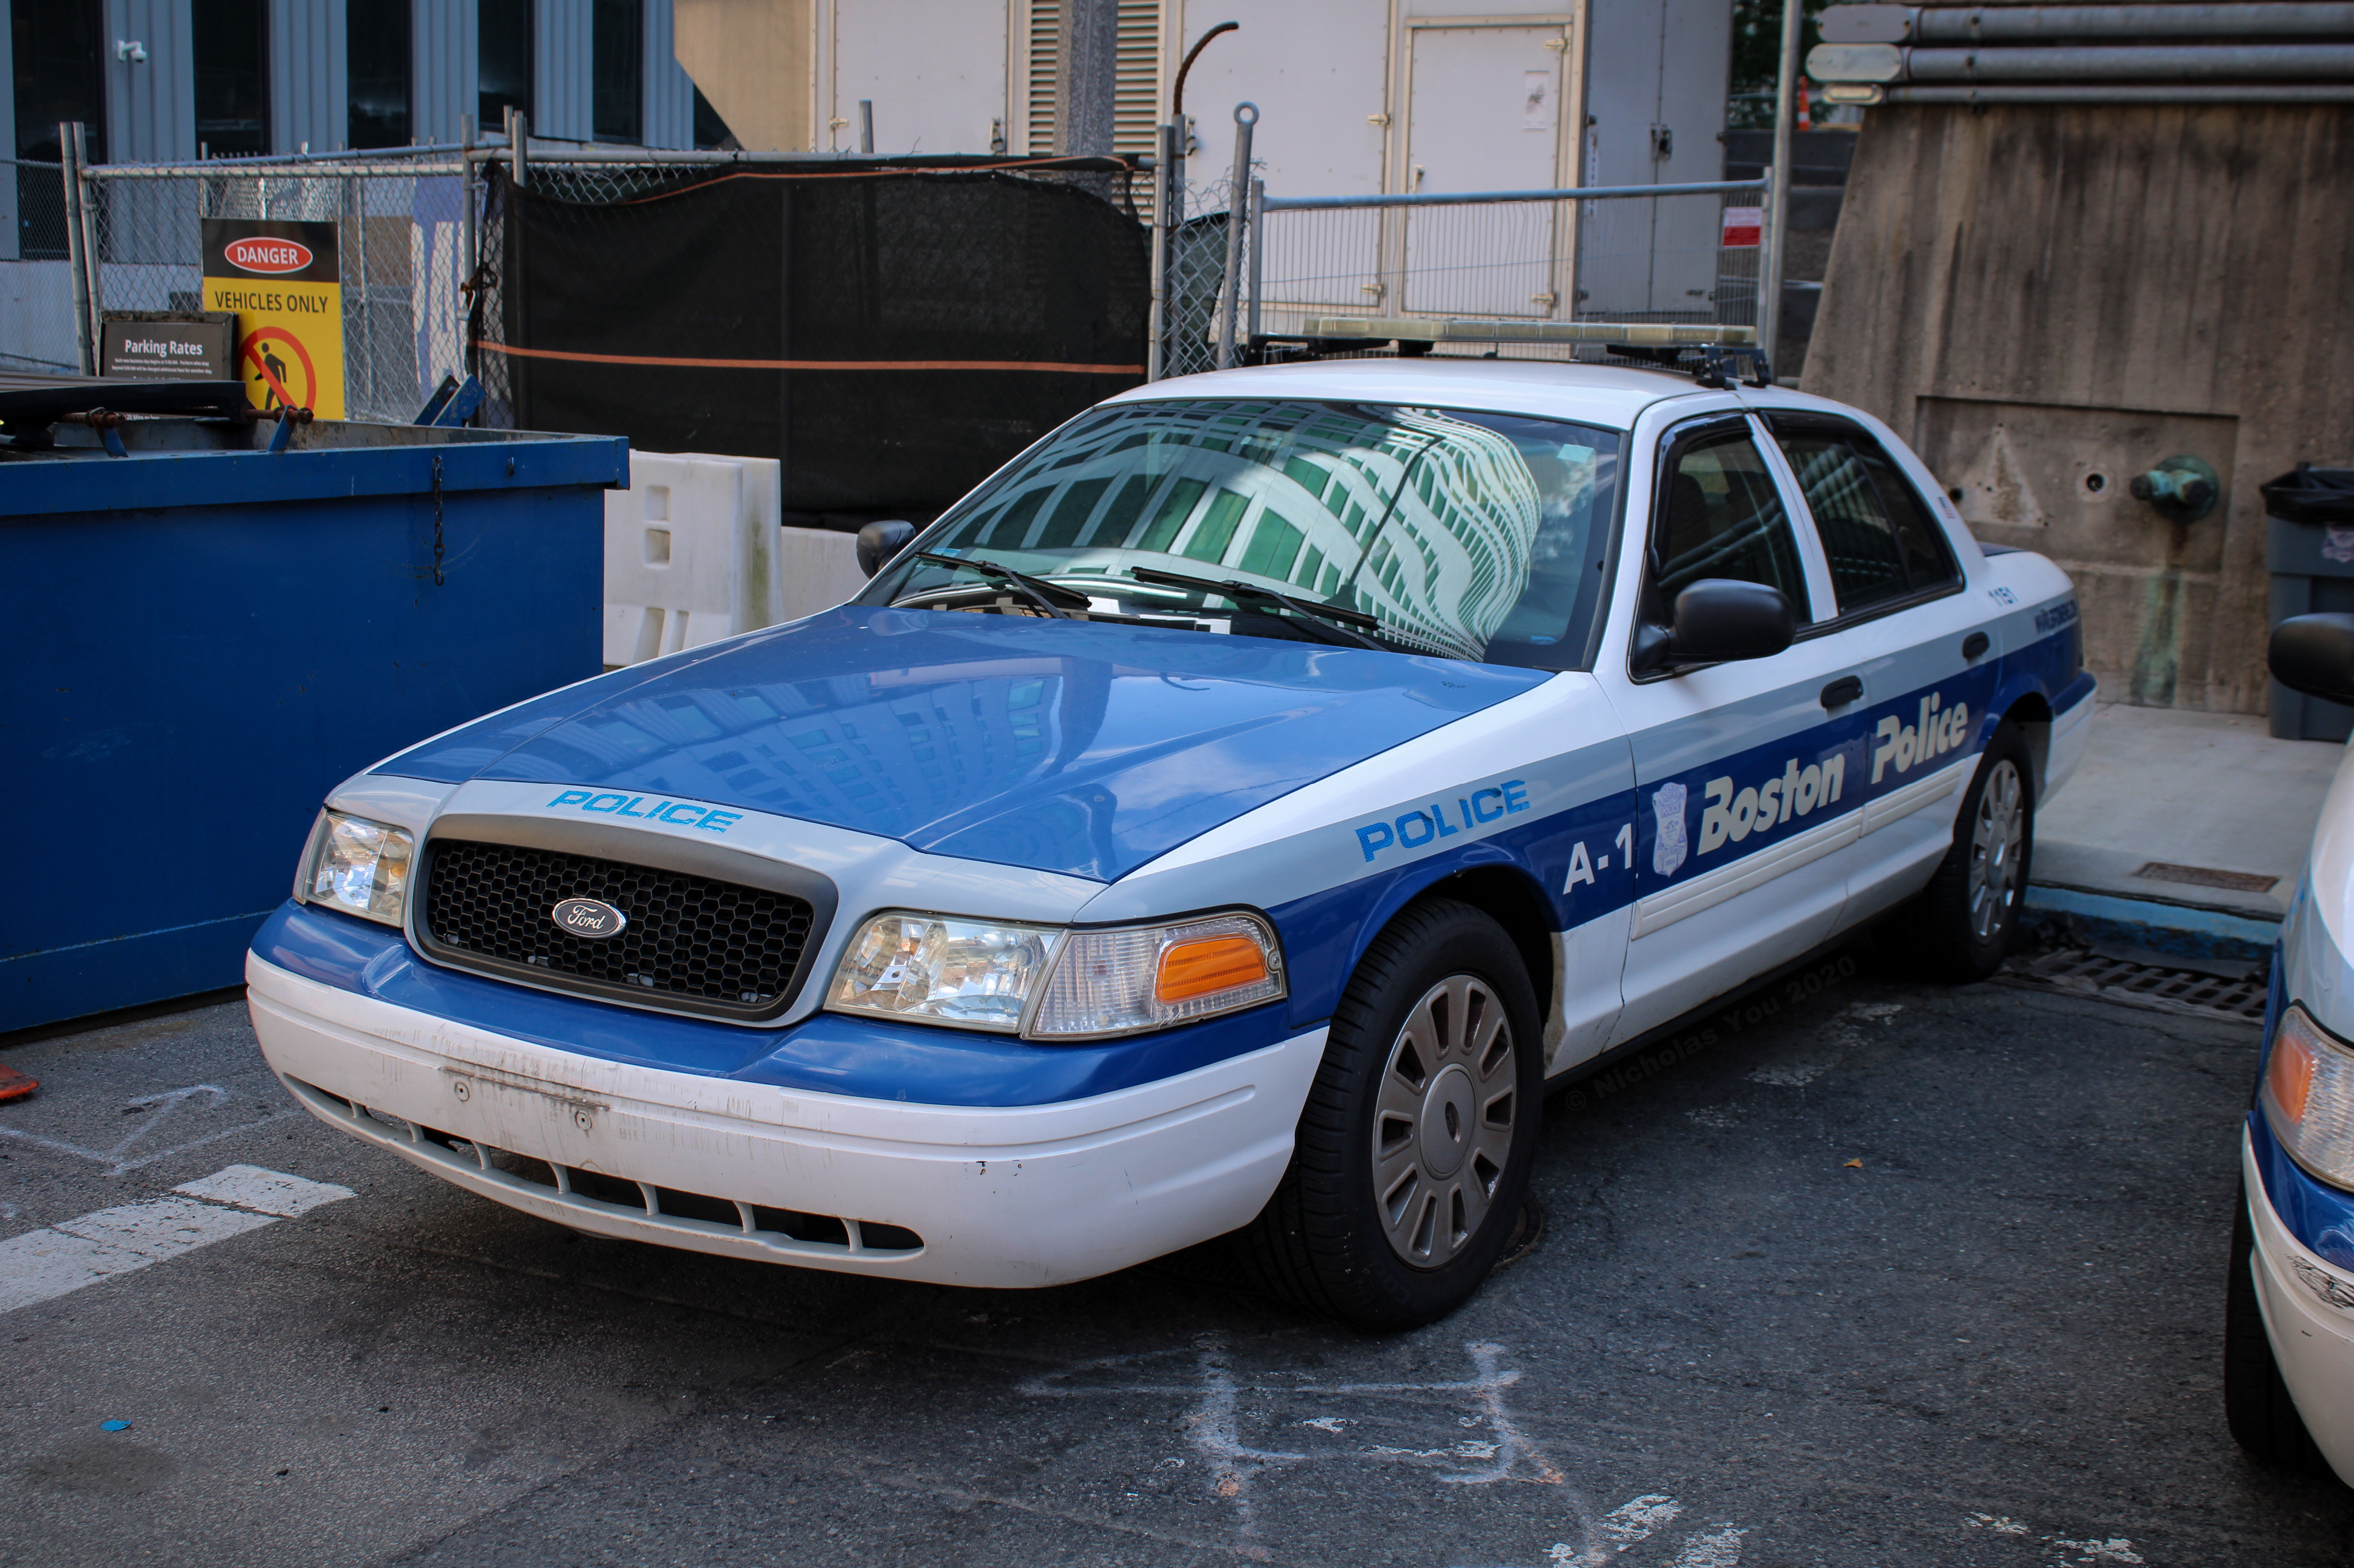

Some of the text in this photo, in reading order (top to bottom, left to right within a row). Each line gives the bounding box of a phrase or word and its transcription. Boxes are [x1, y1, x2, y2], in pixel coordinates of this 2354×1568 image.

[237, 246, 299, 264] DANGER
[214, 291, 328, 314] VEHICLES ONLY
[125, 339, 203, 357] Parking Rates
[1697, 691, 1968, 856] Boston Police
[545, 790, 744, 834] POLICE
[1355, 779, 1530, 862] POLICE
[1563, 823, 1632, 895] A-1
[567, 905, 606, 929] Ford
